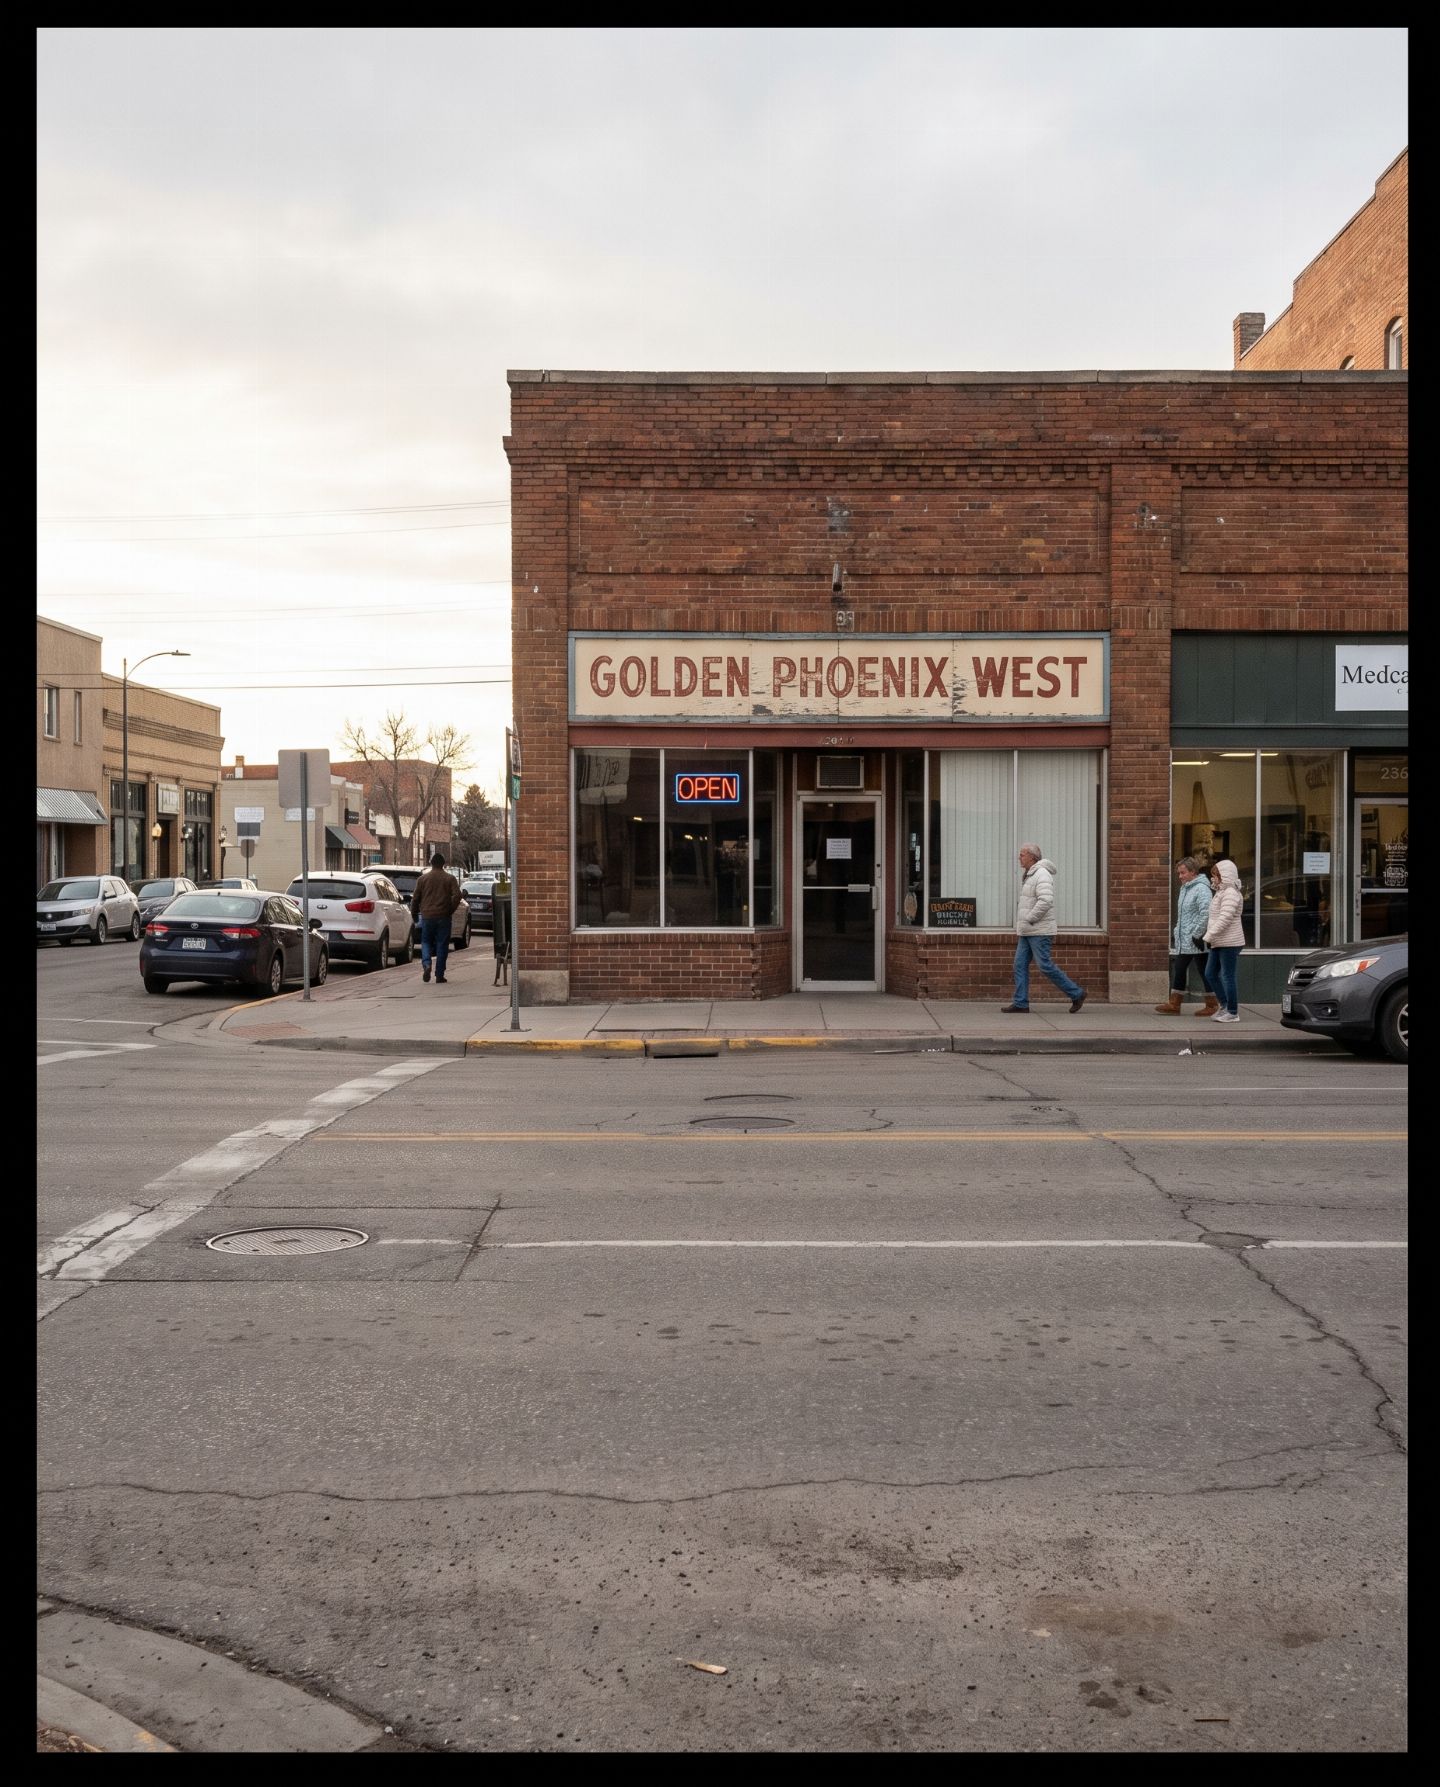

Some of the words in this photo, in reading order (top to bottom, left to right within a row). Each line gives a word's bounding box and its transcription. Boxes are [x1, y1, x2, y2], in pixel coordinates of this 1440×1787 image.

[590, 655, 750, 698] GOLDEN
[773, 656, 949, 698] PHOENIX
[972, 656, 1088, 698] WEST
[1380, 767, 1408, 780] 236
[679, 777, 736, 799] OPEN
